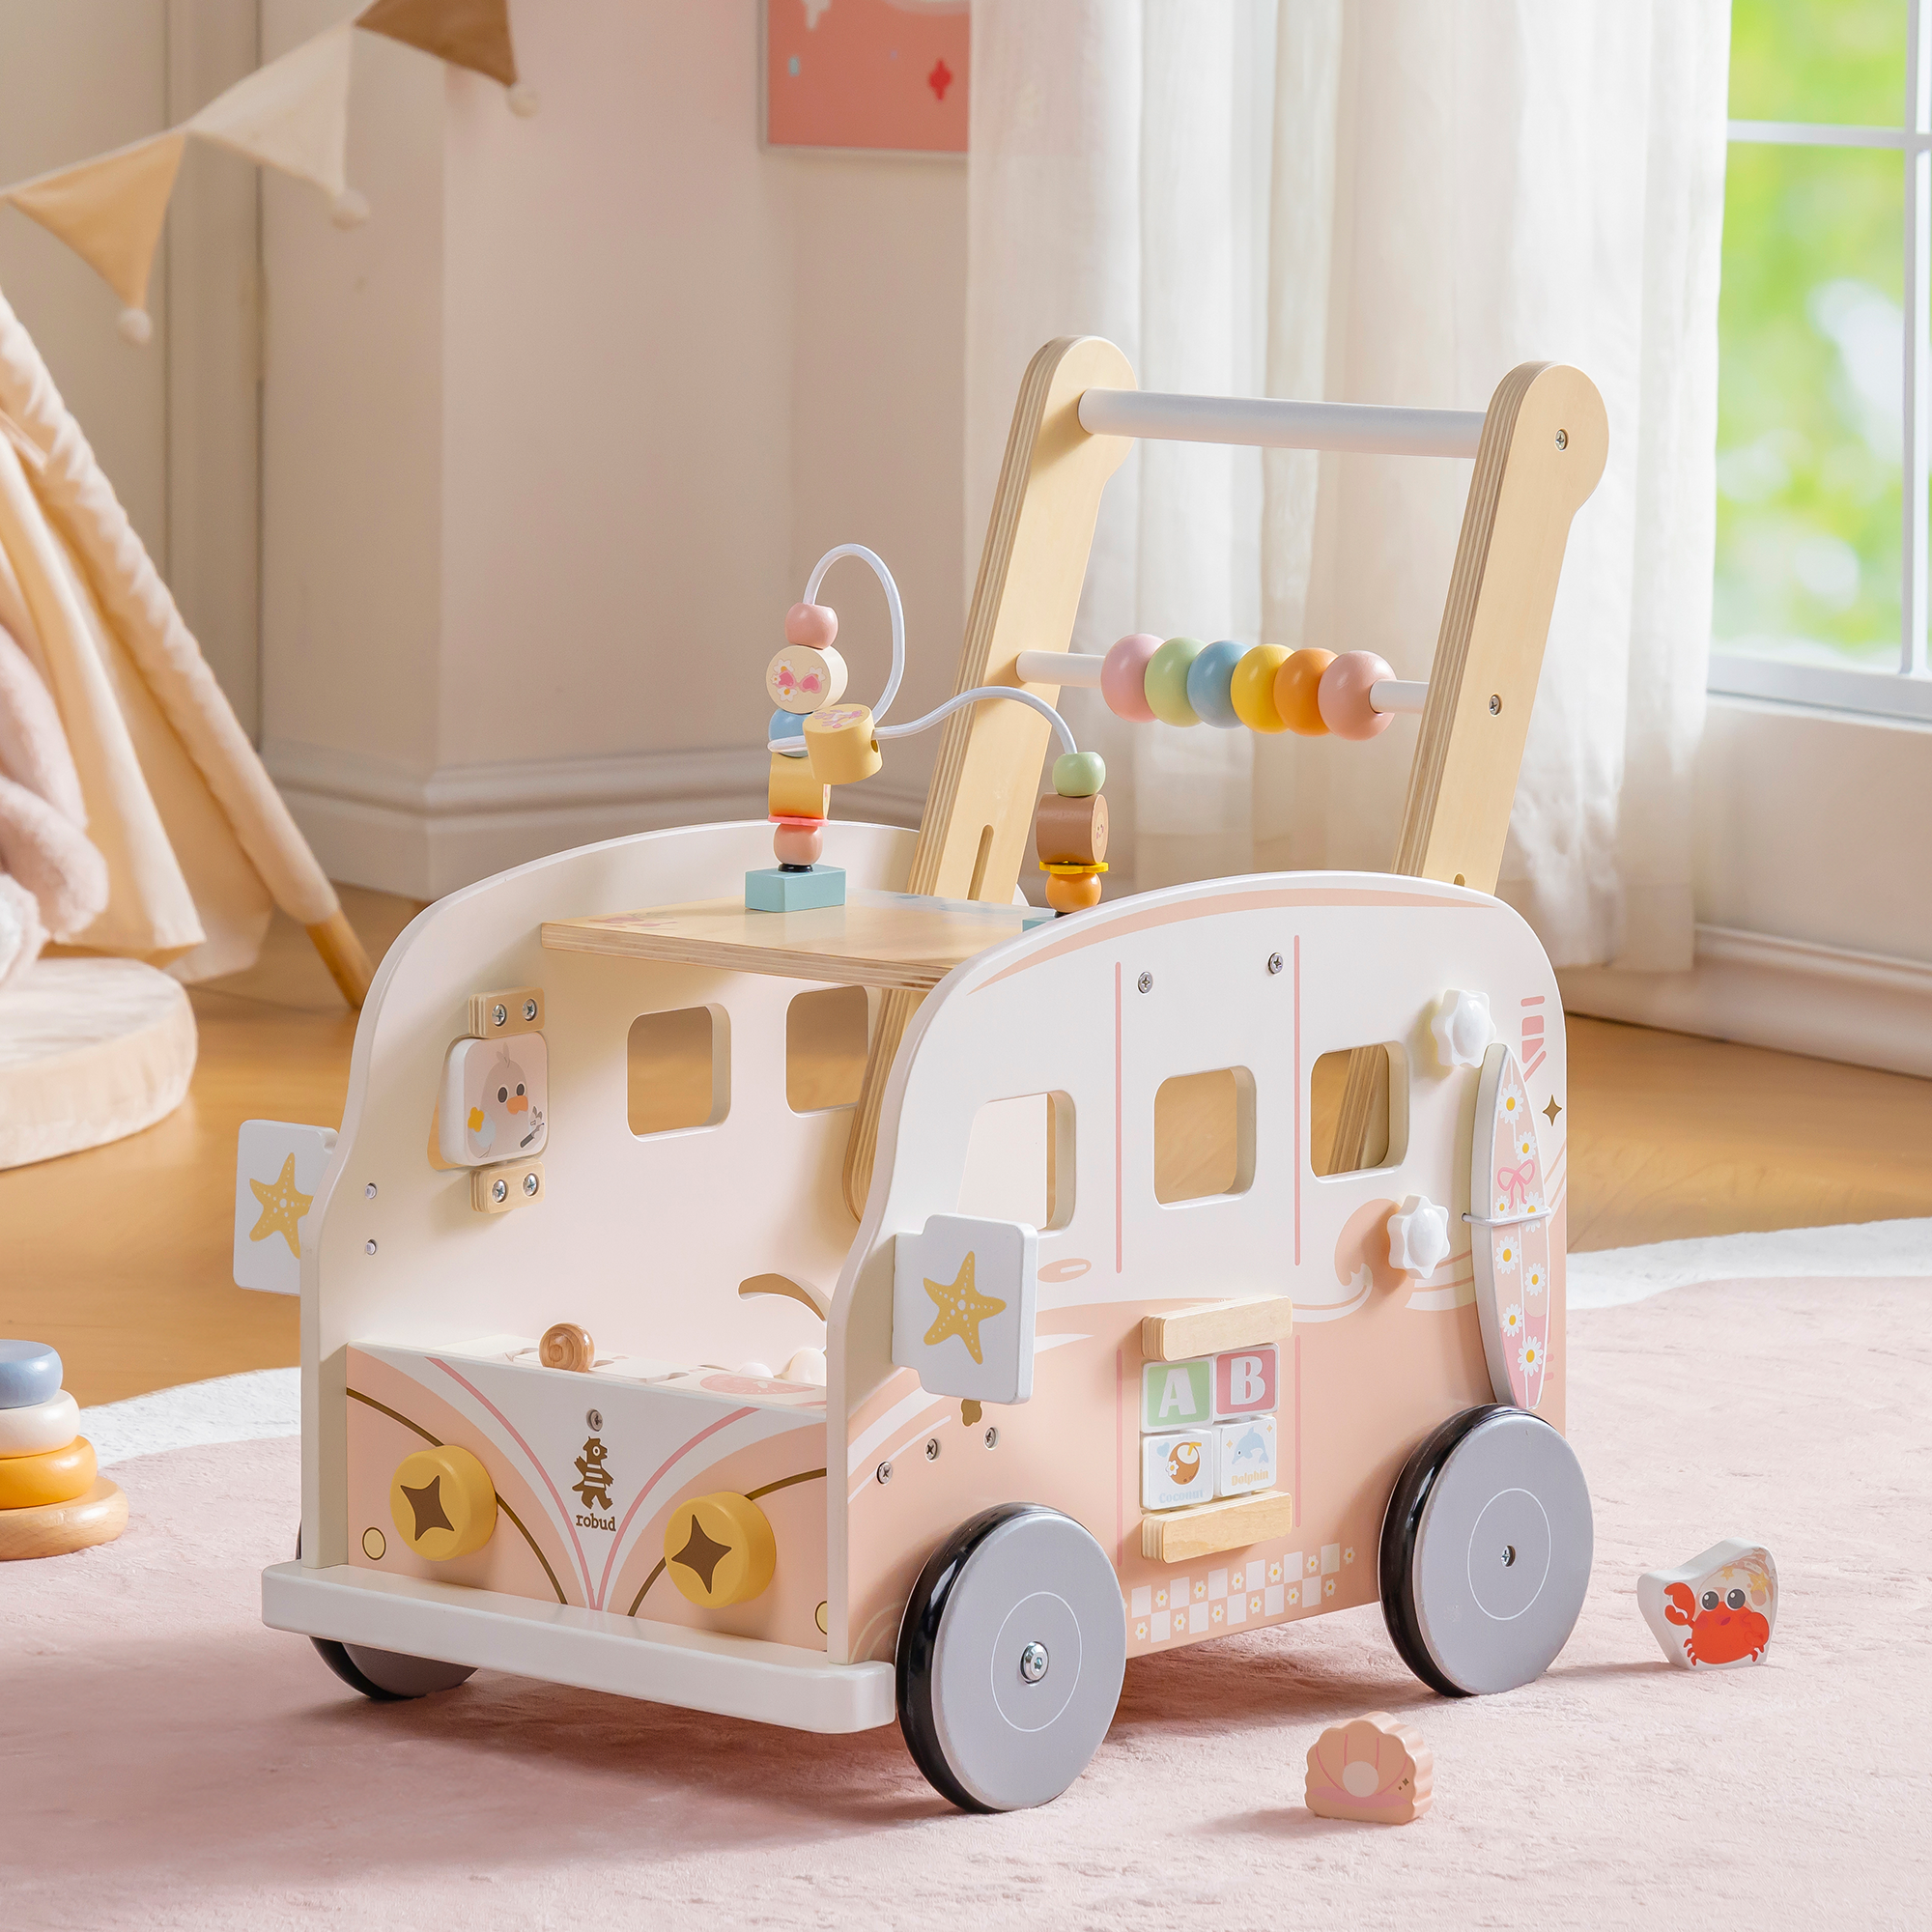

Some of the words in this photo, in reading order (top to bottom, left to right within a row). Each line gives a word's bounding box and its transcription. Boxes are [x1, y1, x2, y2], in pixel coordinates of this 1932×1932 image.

[1230, 1355, 1266, 1406] B
[1158, 1368, 1197, 1418] A
[1231, 1468, 1269, 1487] Dolphin
[1159, 1489, 1204, 1504] Coconut
[575, 1512, 616, 1532] robud
